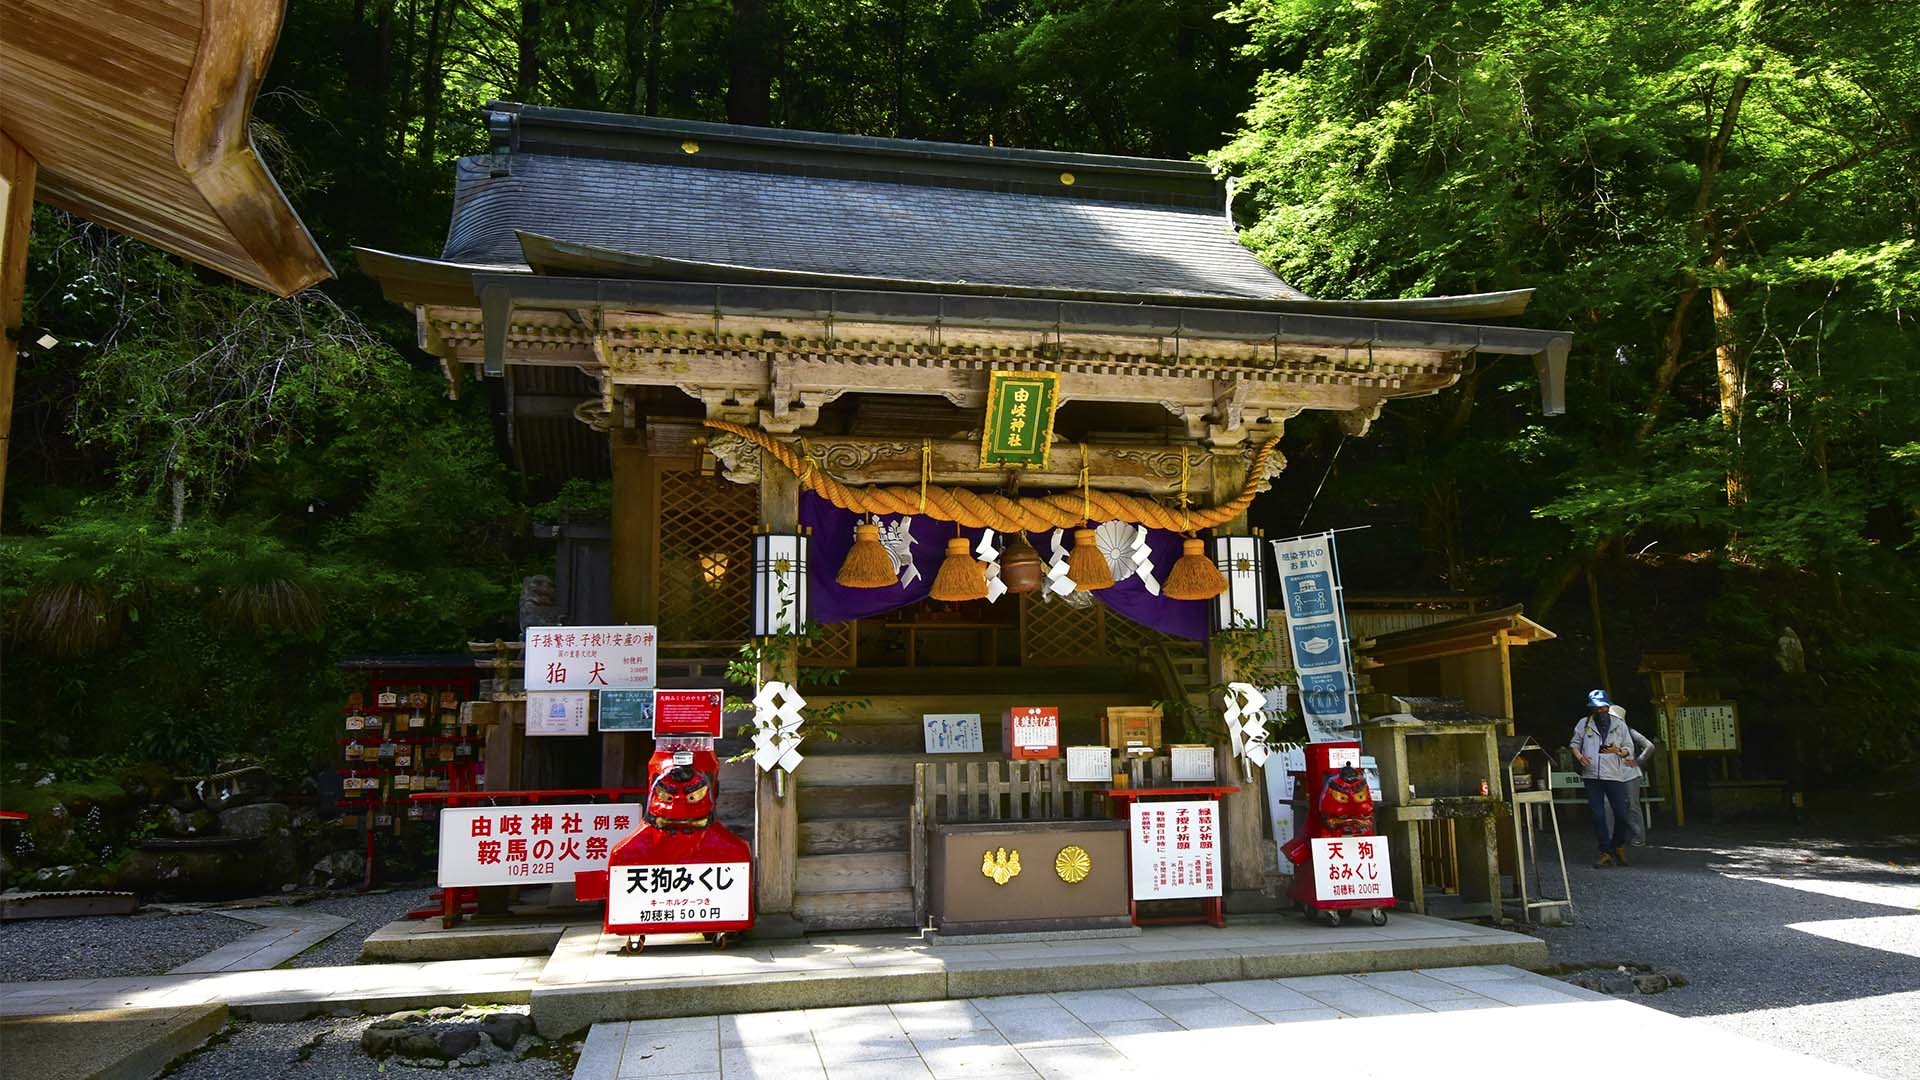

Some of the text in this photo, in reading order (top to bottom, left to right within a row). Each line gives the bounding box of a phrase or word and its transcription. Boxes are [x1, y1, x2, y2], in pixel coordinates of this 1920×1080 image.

[1007, 388, 1029, 447] 由岐神社
[1281, 547, 1324, 562] 感染予防の
[1290, 560, 1318, 570] お願い
[471, 813, 631, 838] 由岐神社 例祭
[1175, 808, 1190, 850] 子授け祈願
[1198, 807, 1213, 849] 縁結び祈願
[477, 835, 609, 865] 鞍馬の火祭
[626, 866, 735, 894] 天狗みくじ
[1329, 863, 1378, 881] おみくじ
[1333, 883, 1380, 896] 初穂料 200円
[650, 897, 712, 907] キーホルダーつき
[639, 908, 675, 922] 初穂料
